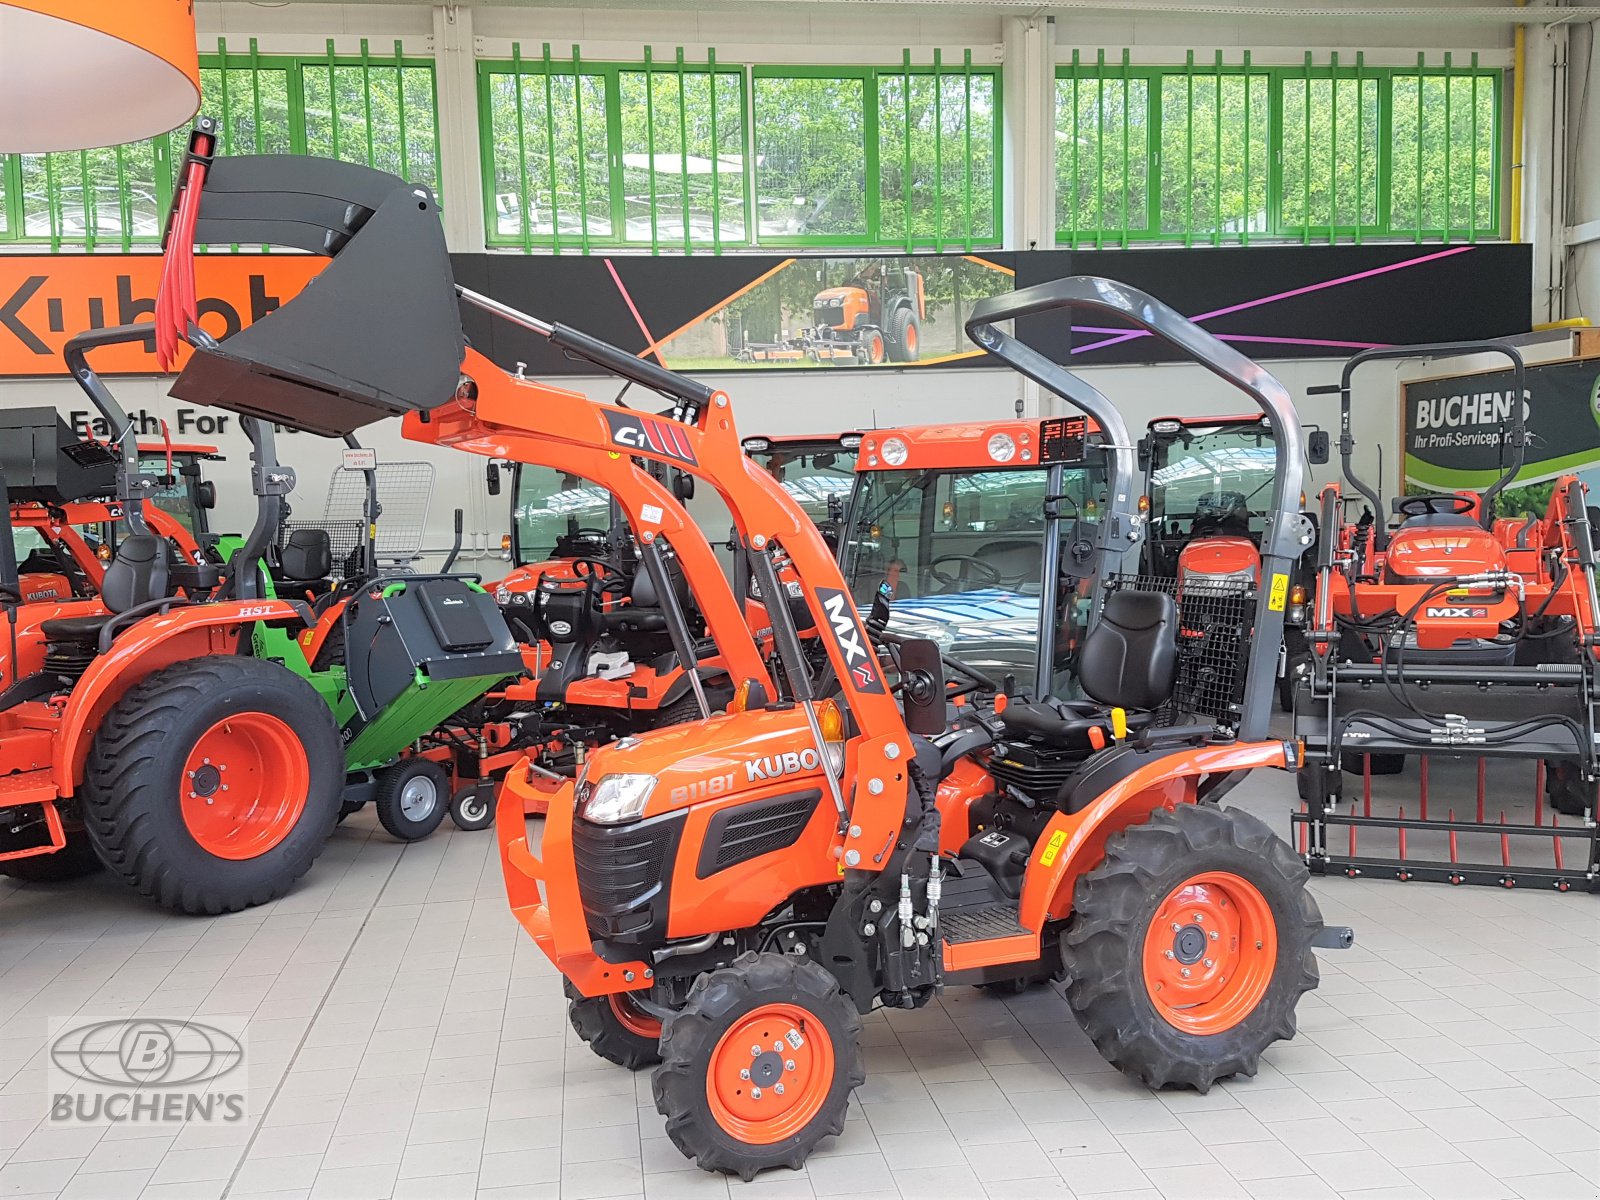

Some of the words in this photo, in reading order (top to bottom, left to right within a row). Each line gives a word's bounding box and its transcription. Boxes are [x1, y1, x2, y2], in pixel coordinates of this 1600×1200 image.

[0, 275, 280, 355] Kubot
[70, 409, 159, 437] Eath
[177, 408, 229, 435] For
[614, 426, 646, 448] C1
[1414, 433, 1428, 449] Ihr
[26, 588, 59, 601] KUBOTA
[239, 605, 274, 617] HST
[1427, 608, 1470, 617] MX
[823, 593, 867, 666] MX
[670, 773, 736, 805] B1181
[744, 747, 820, 783] KUBO
